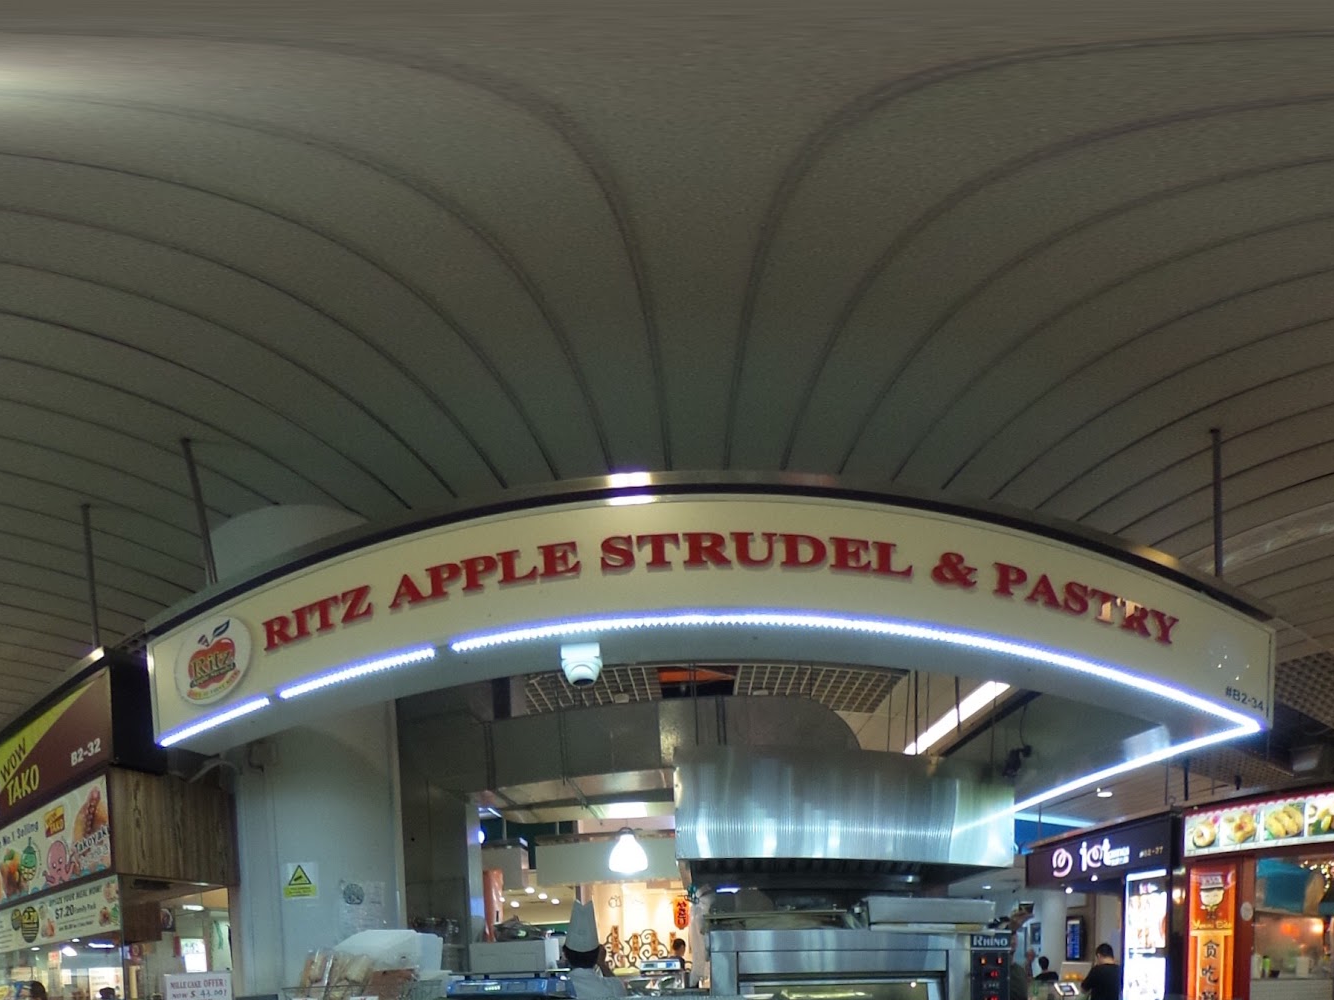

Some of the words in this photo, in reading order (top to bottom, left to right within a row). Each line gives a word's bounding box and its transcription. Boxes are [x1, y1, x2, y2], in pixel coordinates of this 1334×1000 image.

[261, 585, 375, 652] RITZ
[388, 541, 583, 610] APPLE
[600, 531, 914, 578] STRUDEL
[930, 552, 978, 588] &
[992, 562, 1180, 645] PASTRY
[1225, 685, 1265, 711] #B2-34
[0, 738, 26, 782] WOW
[70, 738, 101, 767] B2-32
[6, 764, 39, 806] TAKO
[54, 903, 74, 920] $7.20
